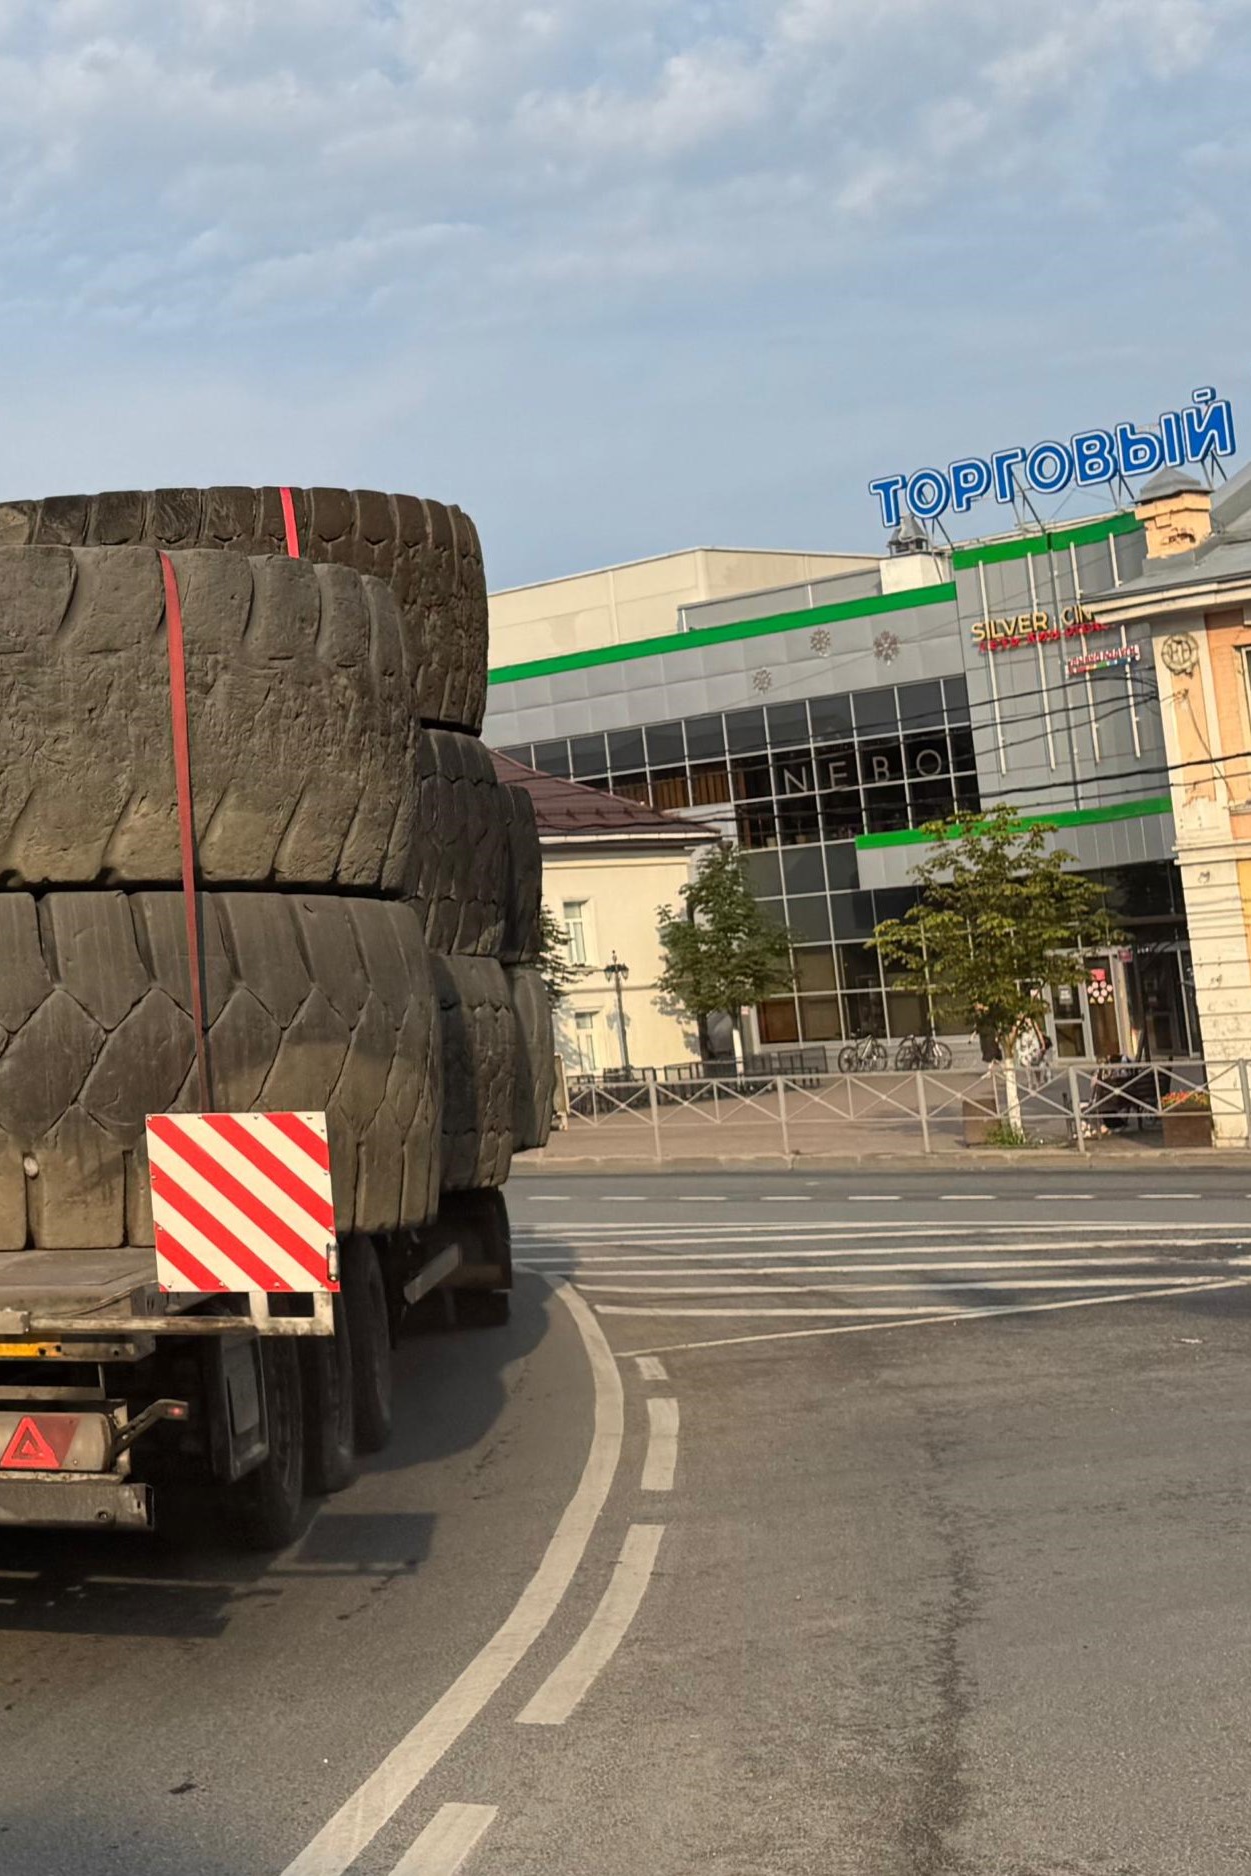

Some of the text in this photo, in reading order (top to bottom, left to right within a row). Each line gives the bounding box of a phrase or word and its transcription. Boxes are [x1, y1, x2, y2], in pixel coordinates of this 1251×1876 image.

[869, 387, 1236, 527] ТОРГОВЫЙ
[971, 611, 1048, 642] SILVER
[1061, 604, 1092, 626] CIN
[783, 749, 942, 795] NEBO
